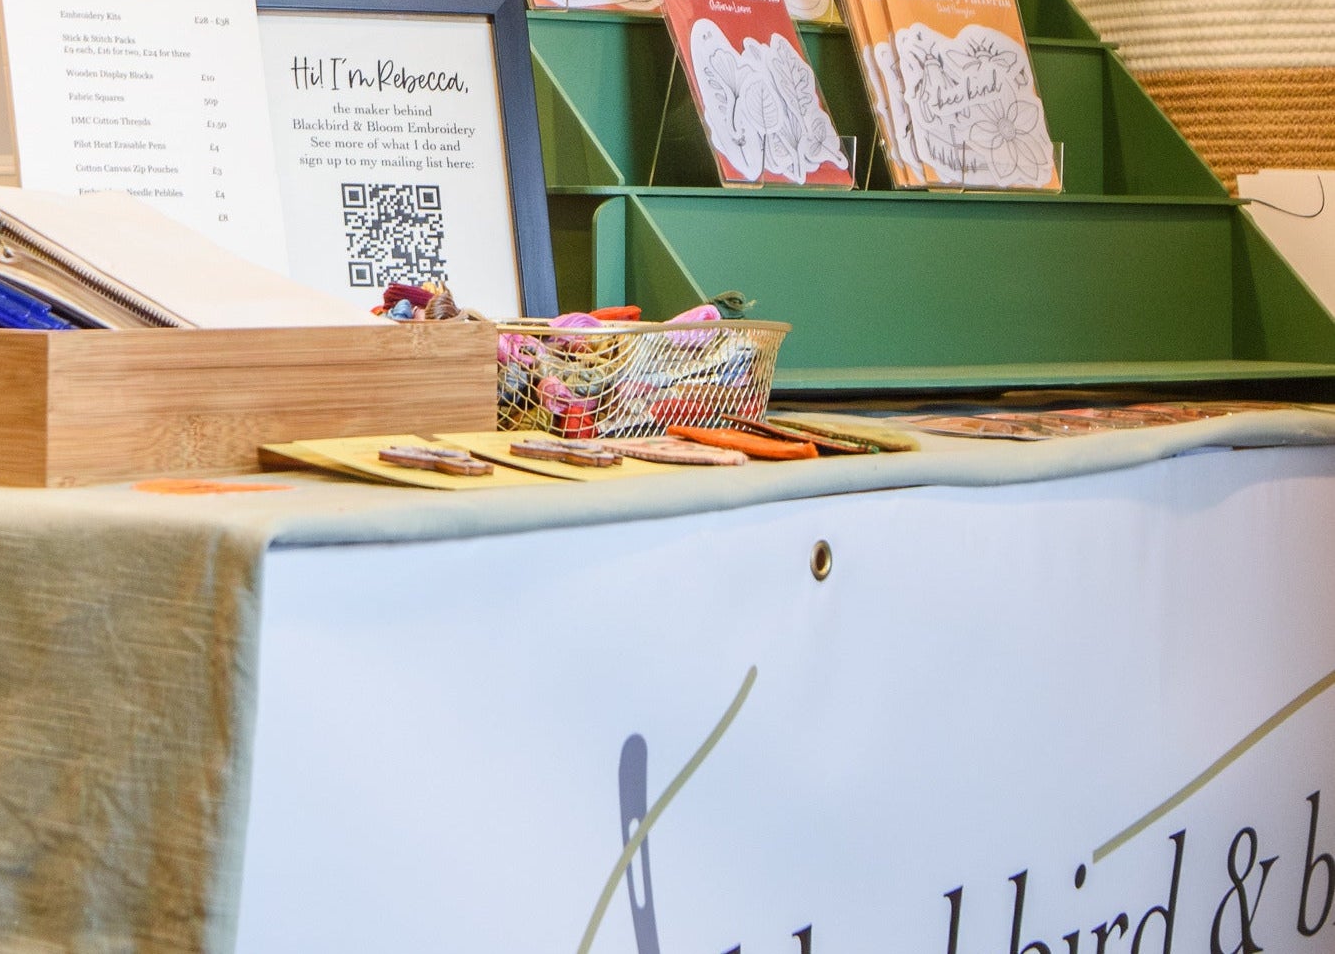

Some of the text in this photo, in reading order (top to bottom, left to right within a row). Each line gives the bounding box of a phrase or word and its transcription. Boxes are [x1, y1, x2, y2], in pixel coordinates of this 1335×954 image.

[60, 10, 104, 21] Embroidery
[107, 12, 121, 21] Kits
[195, 16, 209, 24] £28
[215, 18, 229, 26] £38
[62, 34, 136, 44] Stick & Stitch Packs
[64, 46, 191, 58] £9 each, £16 for two, £24 for three
[66, 69, 215, 82] Wooden Display Blocks £10
[291, 56, 323, 90] Hi!
[377, 60, 469, 94] Rebecca,
[932, 69, 1002, 110] bee kind
[69, 92, 218, 106] Fabric Squares 50p
[333, 102, 433, 116] the maker behind
[71, 116, 227, 129] DMC Cotton Threads £1.50
[293, 119, 475, 138] Blackbird & Bloom Embroidery
[73, 140, 219, 152] Pilot Heat Erasable Pens £4
[311, 137, 461, 152] See more of what I do and
[299, 154, 475, 170] sign up to my mailing list here:
[76, 164, 223, 176] Cotton Canvas Zip Pouches £3
[127, 188, 153, 197] Needle
[155, 189, 183, 198] Pebbles
[216, 190, 225, 199] £4
[219, 214, 229, 222] £8
[1210, 826, 1279, 954] &
